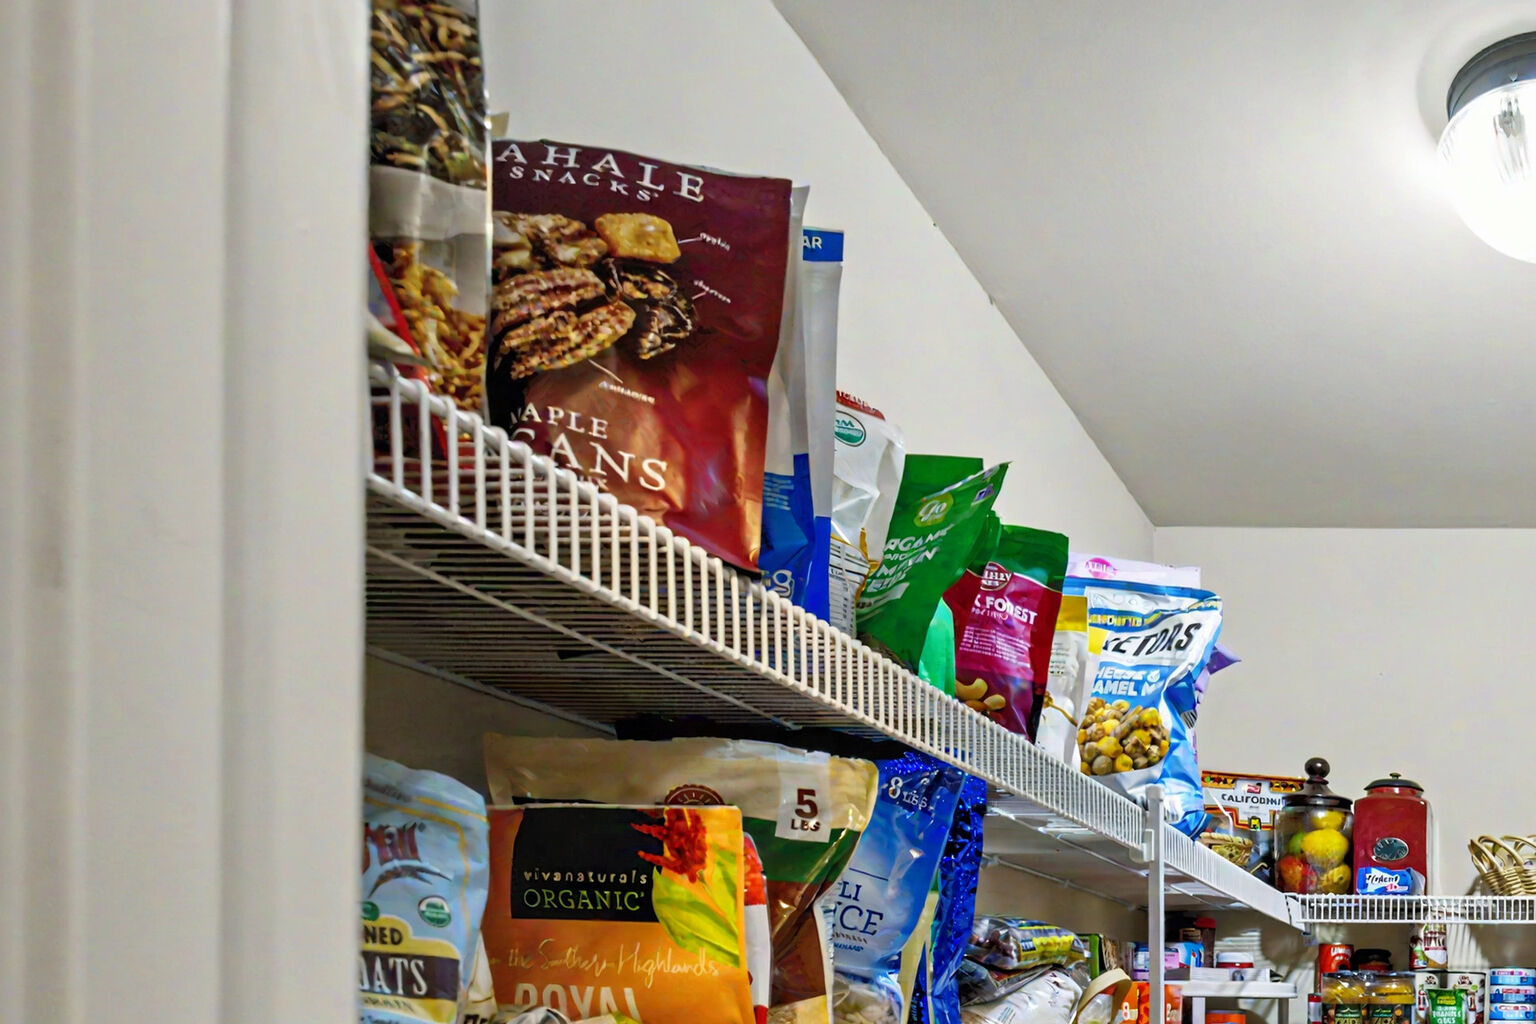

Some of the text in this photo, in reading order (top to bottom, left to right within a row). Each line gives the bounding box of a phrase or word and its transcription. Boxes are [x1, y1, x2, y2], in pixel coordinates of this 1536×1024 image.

[509, 166, 652, 202] SNACKS
[794, 788, 819, 821] 5
[790, 819, 821, 832] LBS
[523, 889, 643, 911] ORGANIC
